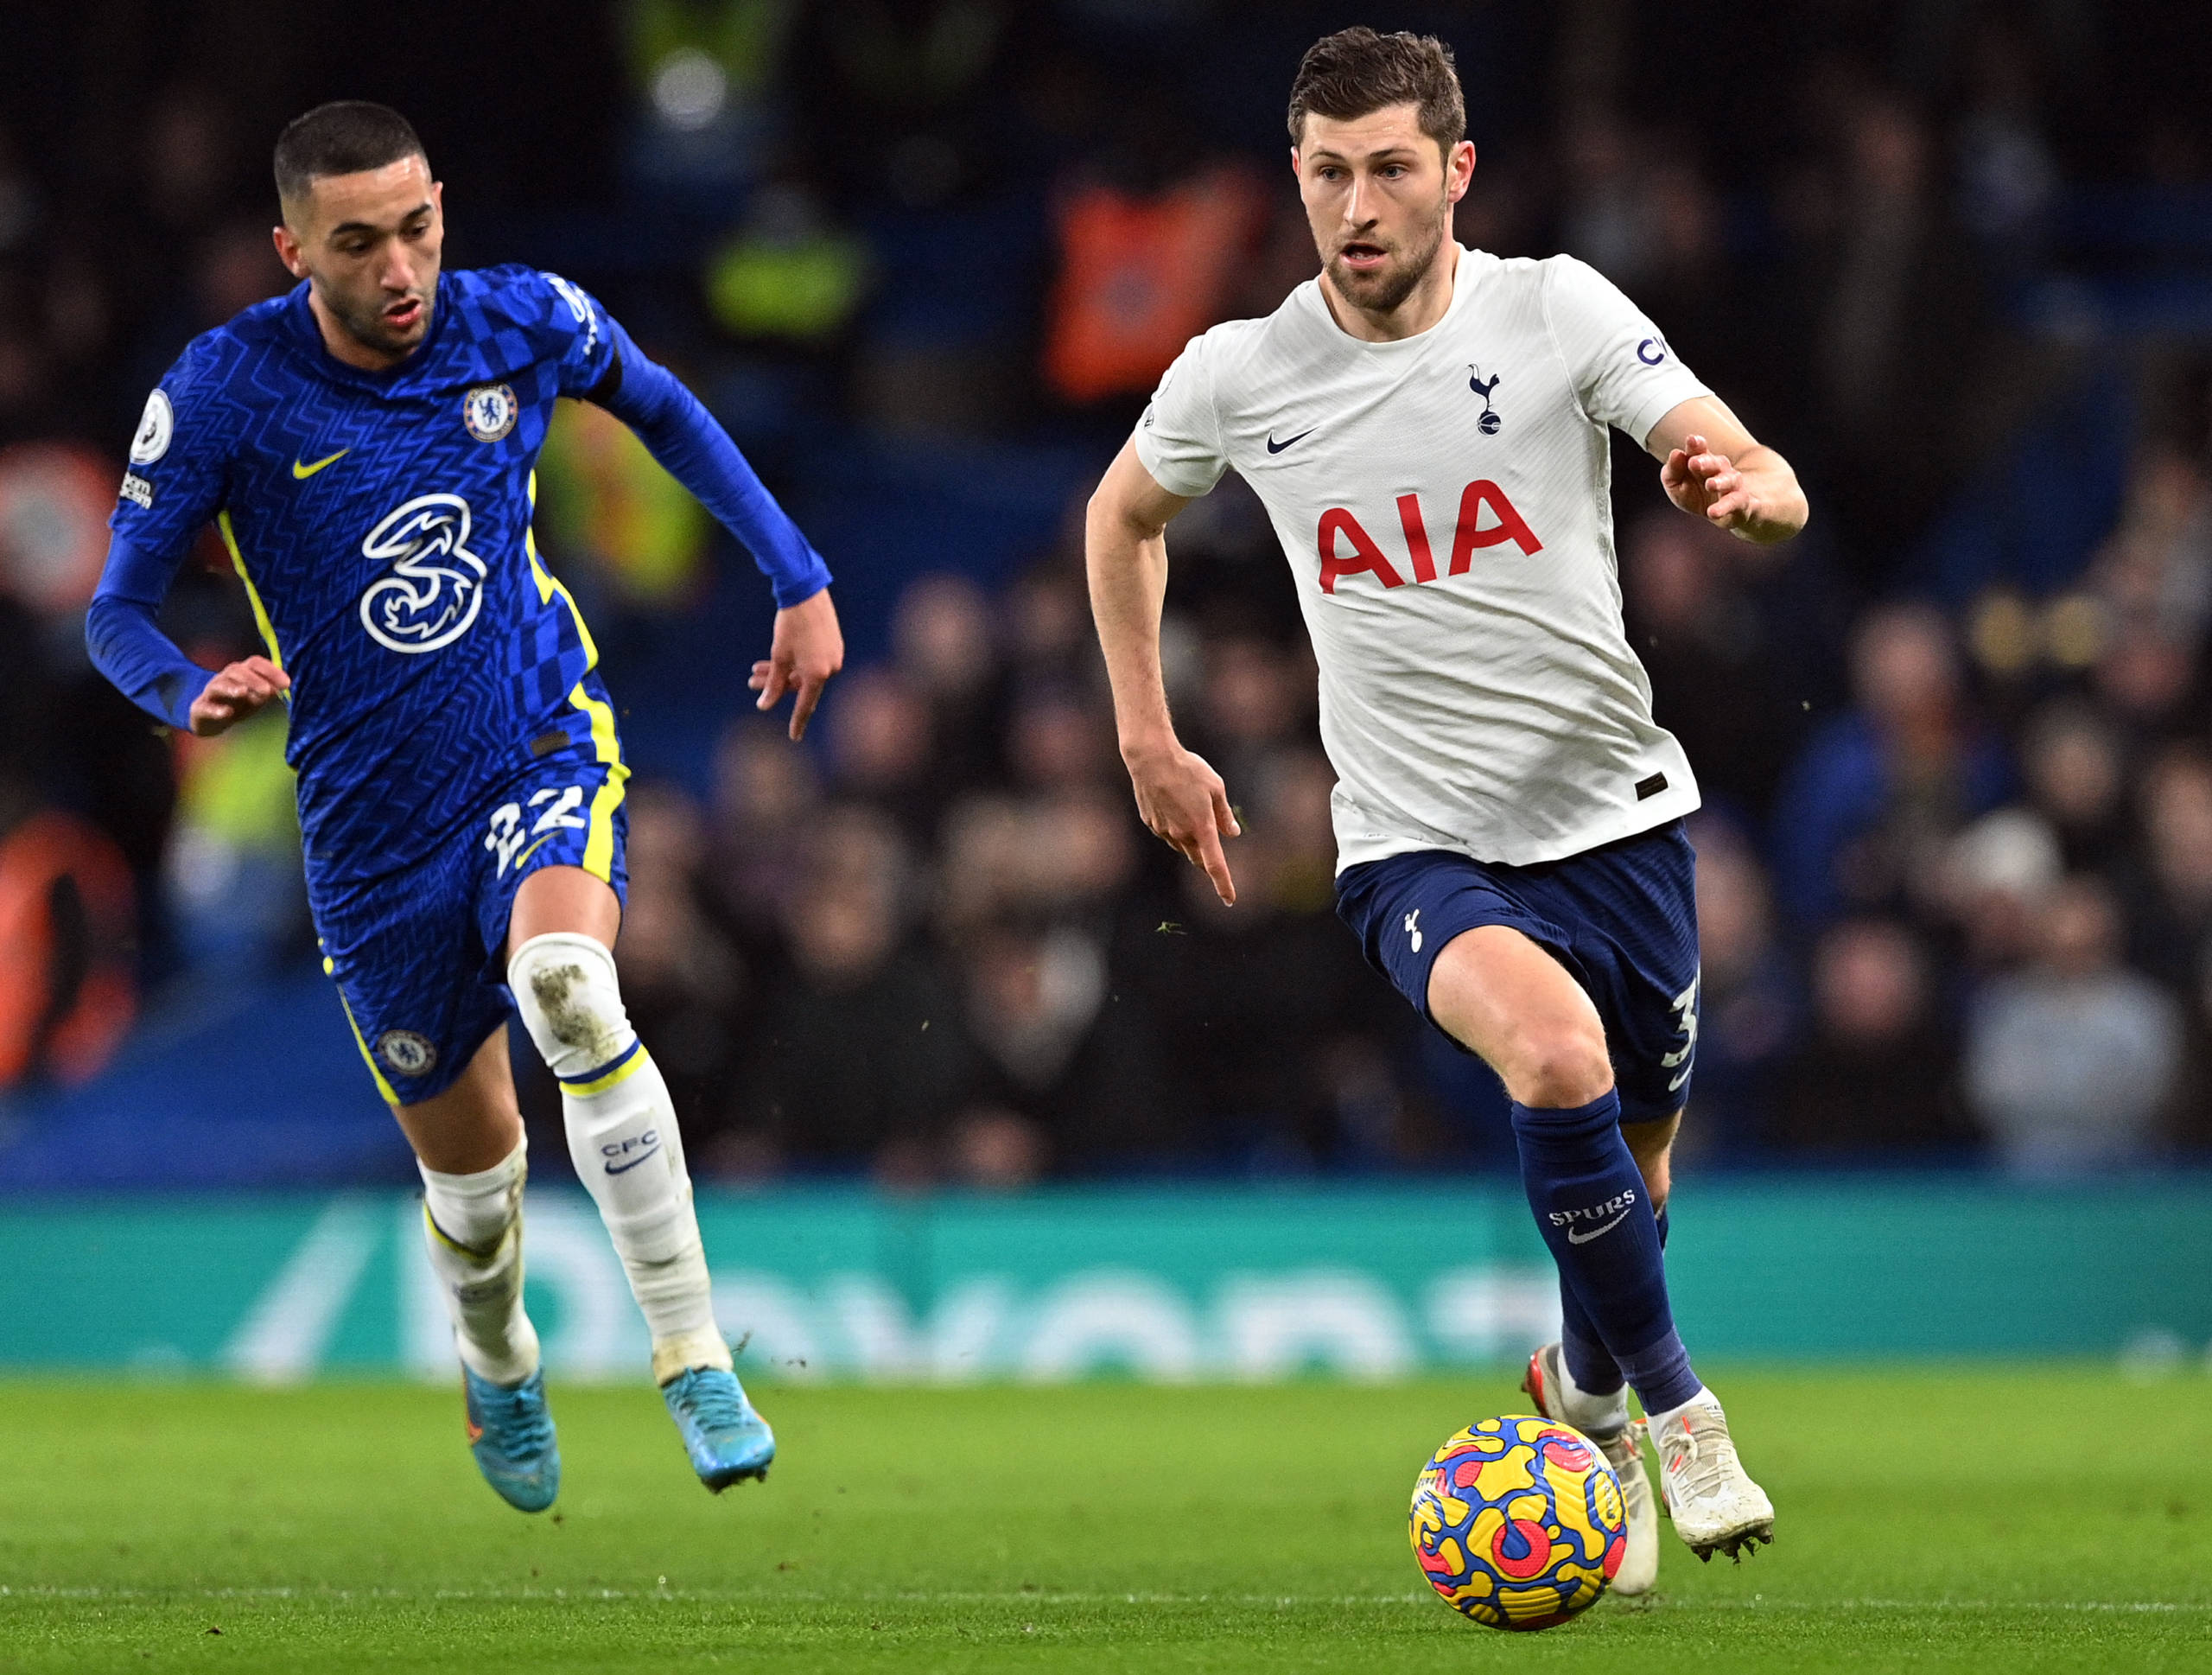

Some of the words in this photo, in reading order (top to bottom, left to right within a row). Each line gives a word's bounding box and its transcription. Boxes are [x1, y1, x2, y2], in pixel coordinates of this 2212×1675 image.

[1318, 480, 1543, 595] AIA
[484, 785, 586, 880] 22
[1661, 961, 1700, 1067] 3
[601, 1130, 658, 1156] CFC
[1548, 1189, 1636, 1226] SPURS
